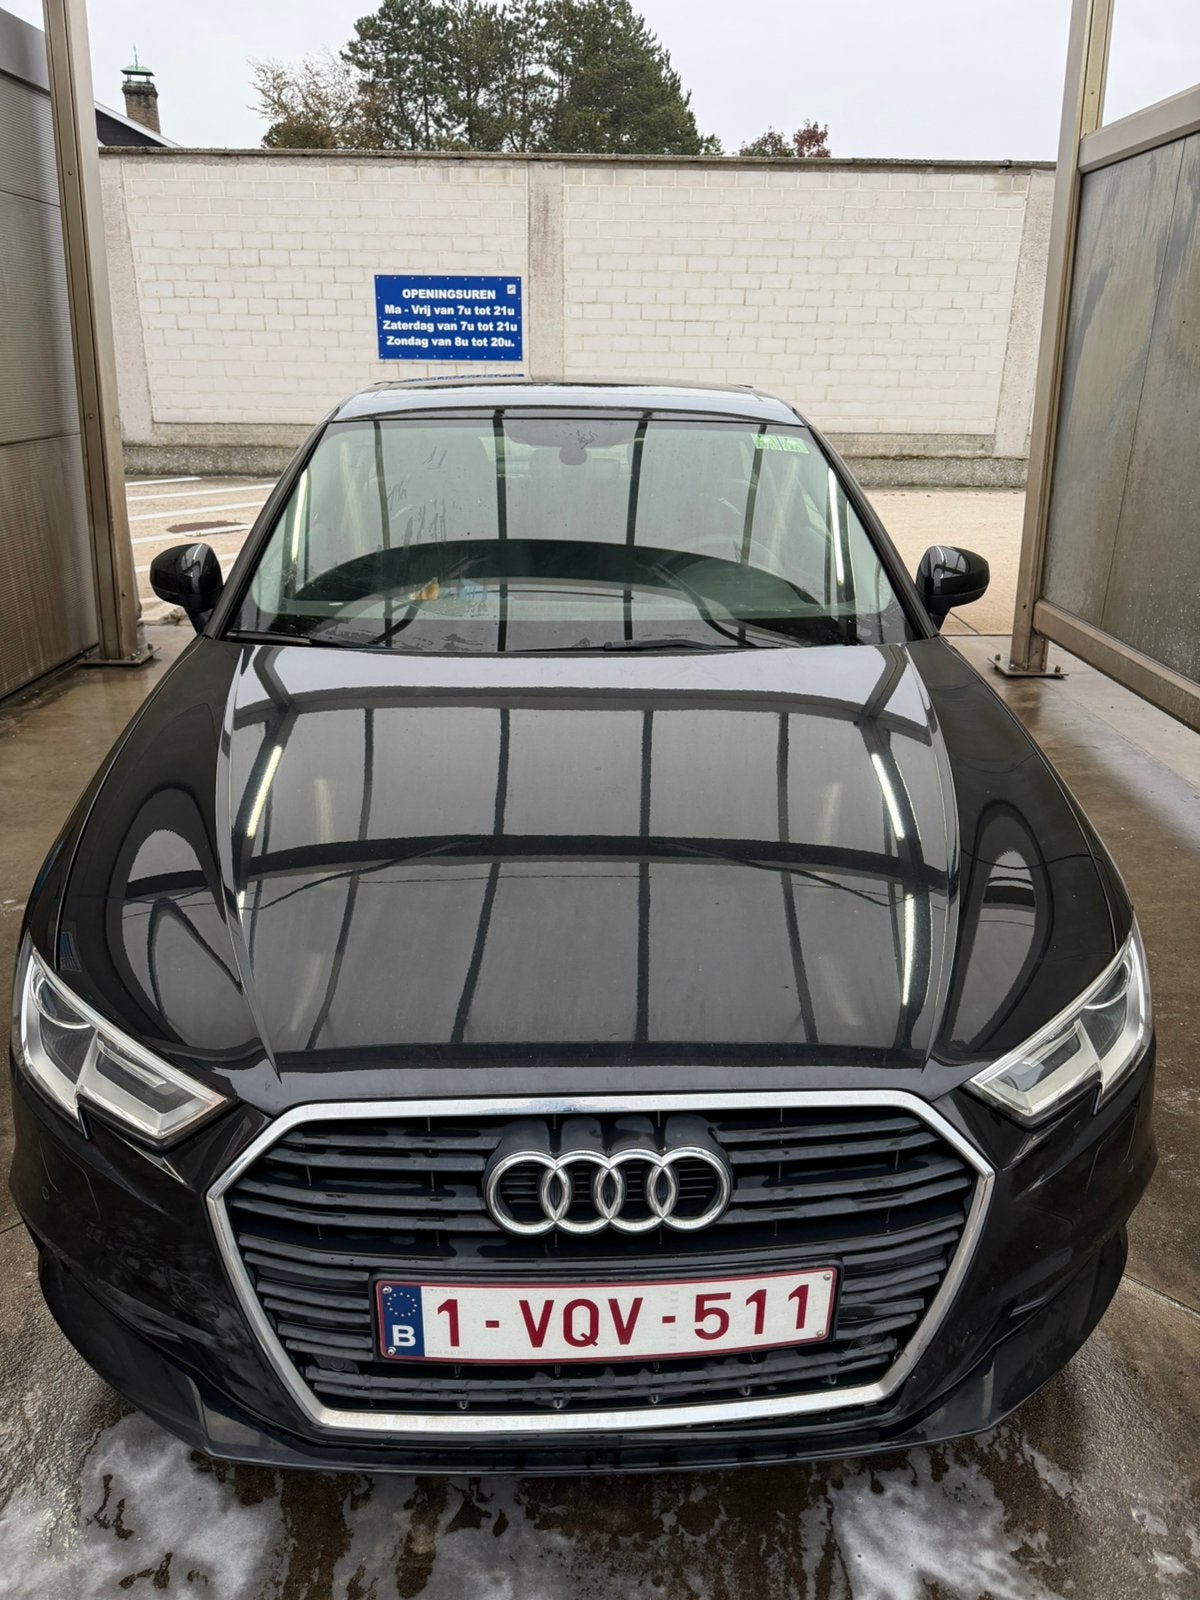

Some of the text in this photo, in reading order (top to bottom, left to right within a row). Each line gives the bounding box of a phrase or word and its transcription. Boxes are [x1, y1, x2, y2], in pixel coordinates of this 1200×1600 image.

[402, 289, 496, 299] OPENINGSUREN
[385, 305, 401, 314] Ma
[411, 305, 431, 316] Vrij
[434, 307, 454, 315] van
[457, 306, 471, 315] 7u
[474, 306, 491, 315] tot
[494, 306, 515, 315] 21u
[383, 321, 517, 332] Zaterdag van 7u tot 21u
[387, 336, 515, 347] Zondag van 8u tot 20u.
[392, 1325, 415, 1347] B
